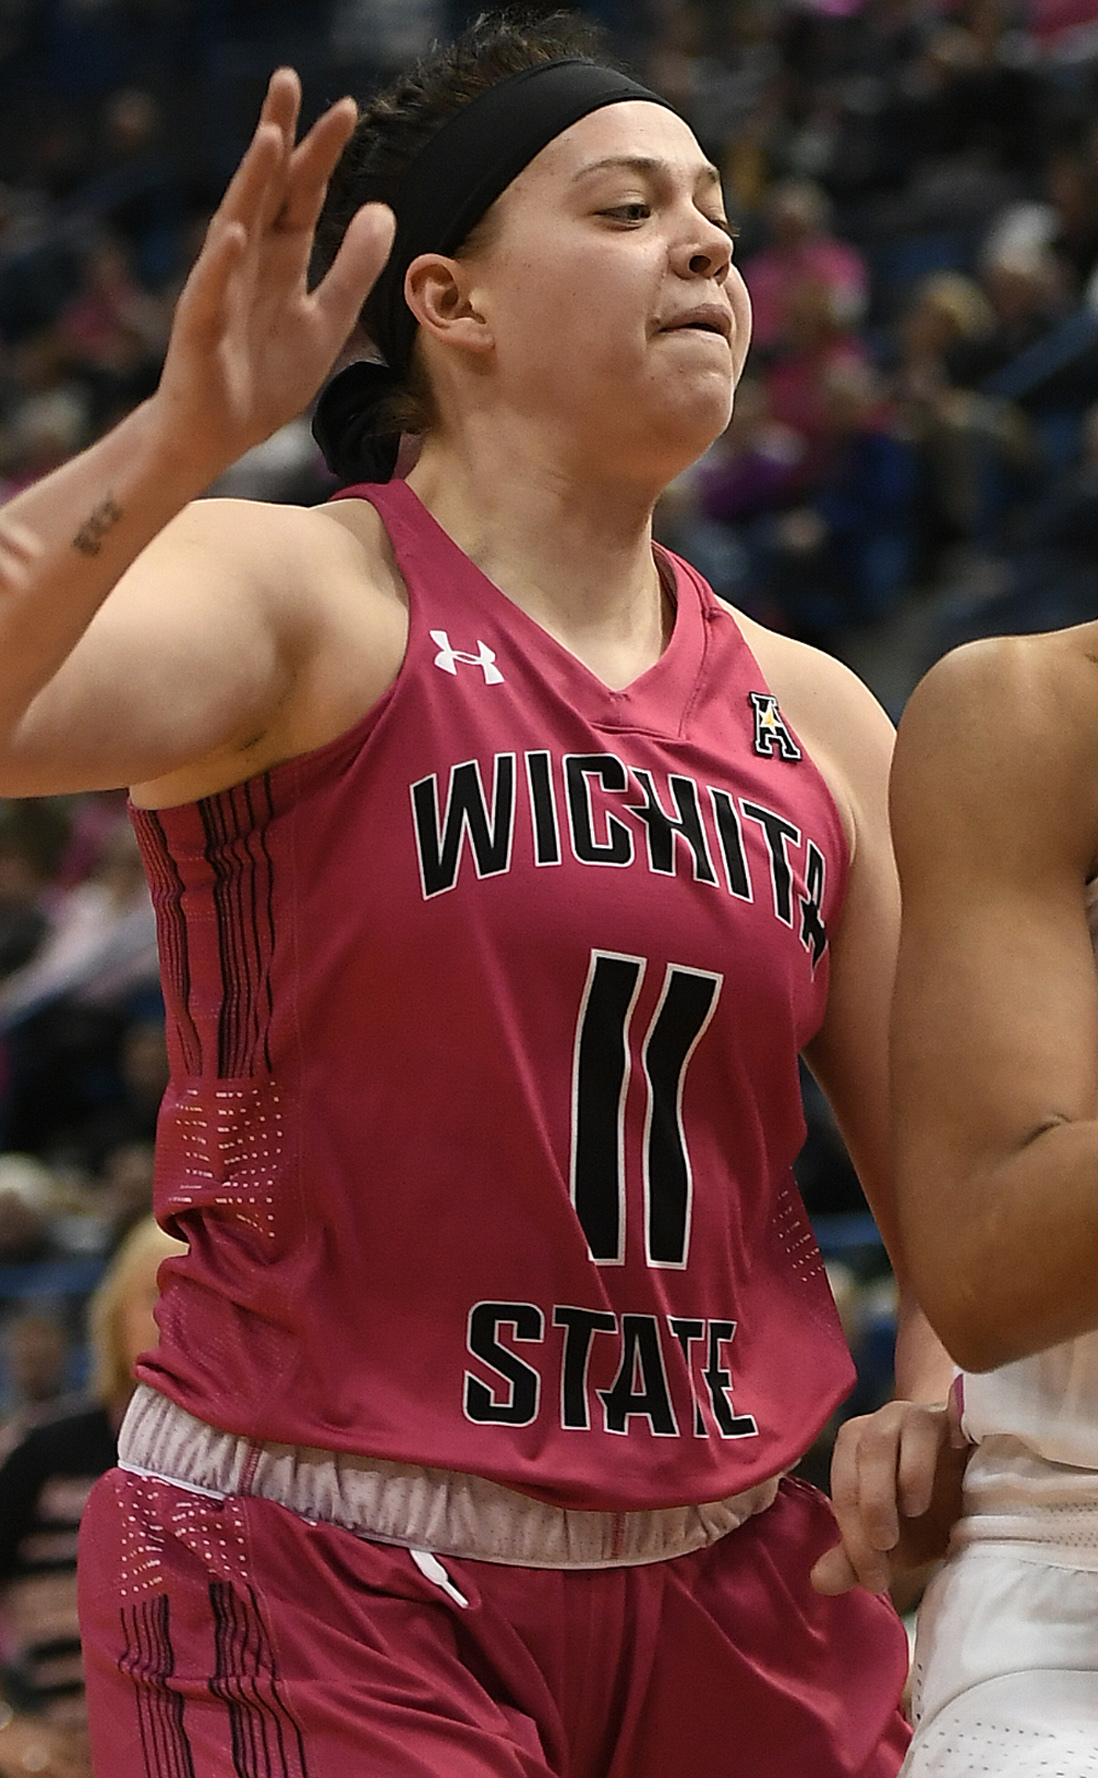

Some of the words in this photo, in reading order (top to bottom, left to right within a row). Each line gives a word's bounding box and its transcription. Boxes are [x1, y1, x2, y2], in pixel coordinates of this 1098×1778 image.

[749, 691, 802, 762] A
[410, 749, 829, 983] WICHITA
[569, 948, 725, 1271] 11
[463, 1299, 759, 1439] STATE
